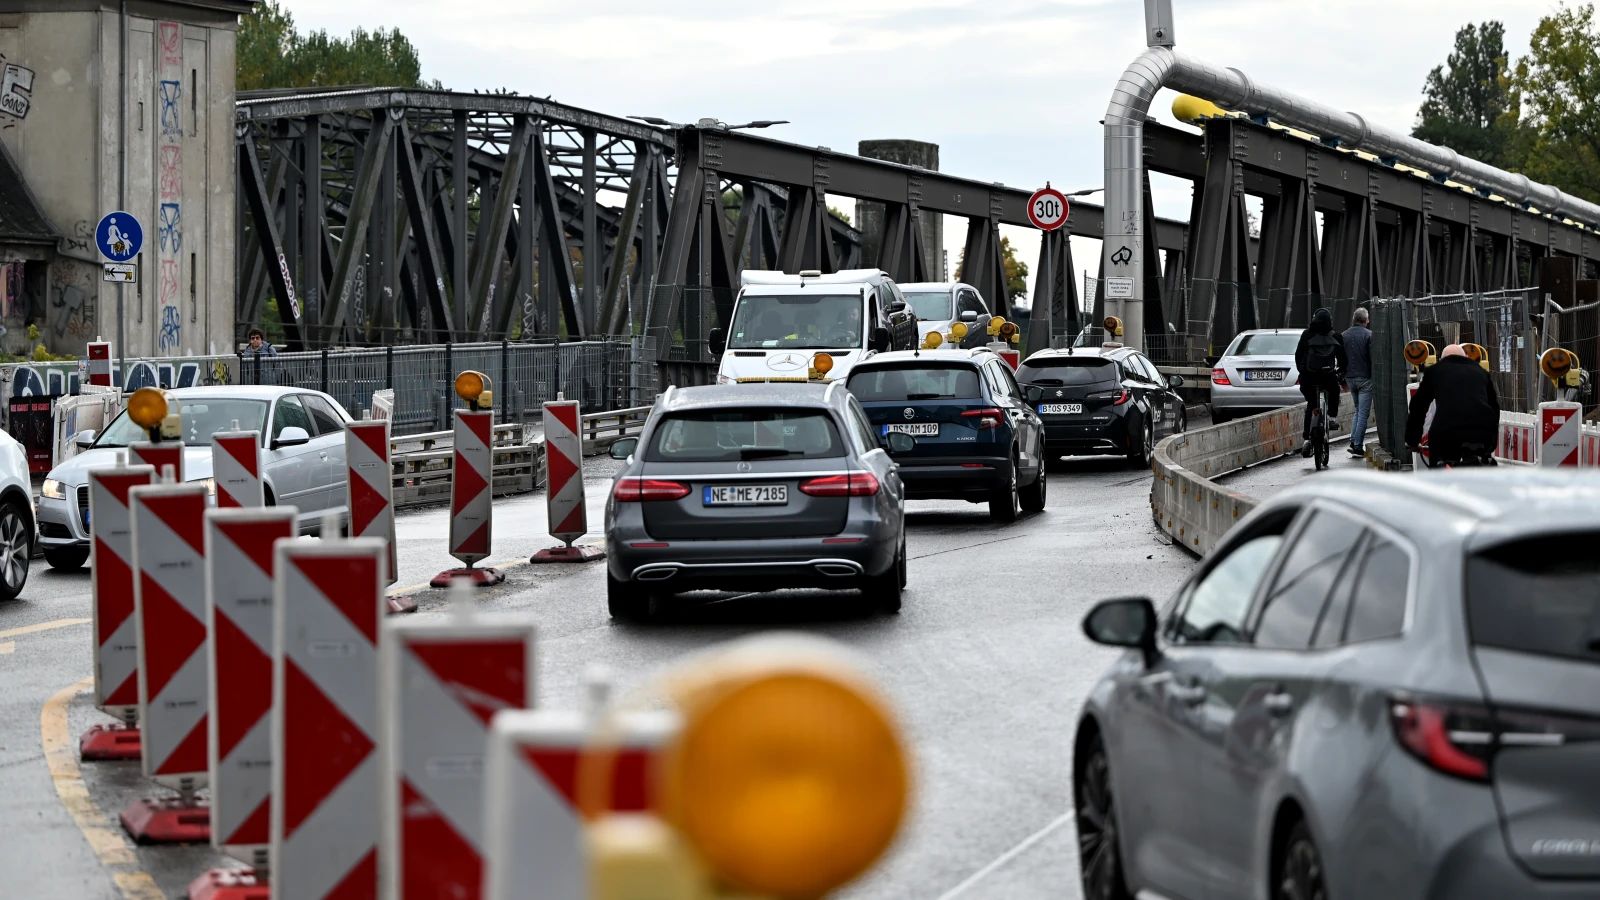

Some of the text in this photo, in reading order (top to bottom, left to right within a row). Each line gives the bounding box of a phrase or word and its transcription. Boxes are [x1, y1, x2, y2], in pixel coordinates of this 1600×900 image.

[1036, 200, 1060, 219] 30t
[1042, 403, 1081, 413] B OS 9349
[909, 424, 921, 434] AM
[922, 424, 938, 434] 109
[712, 486, 786, 502] NE ME 7185
